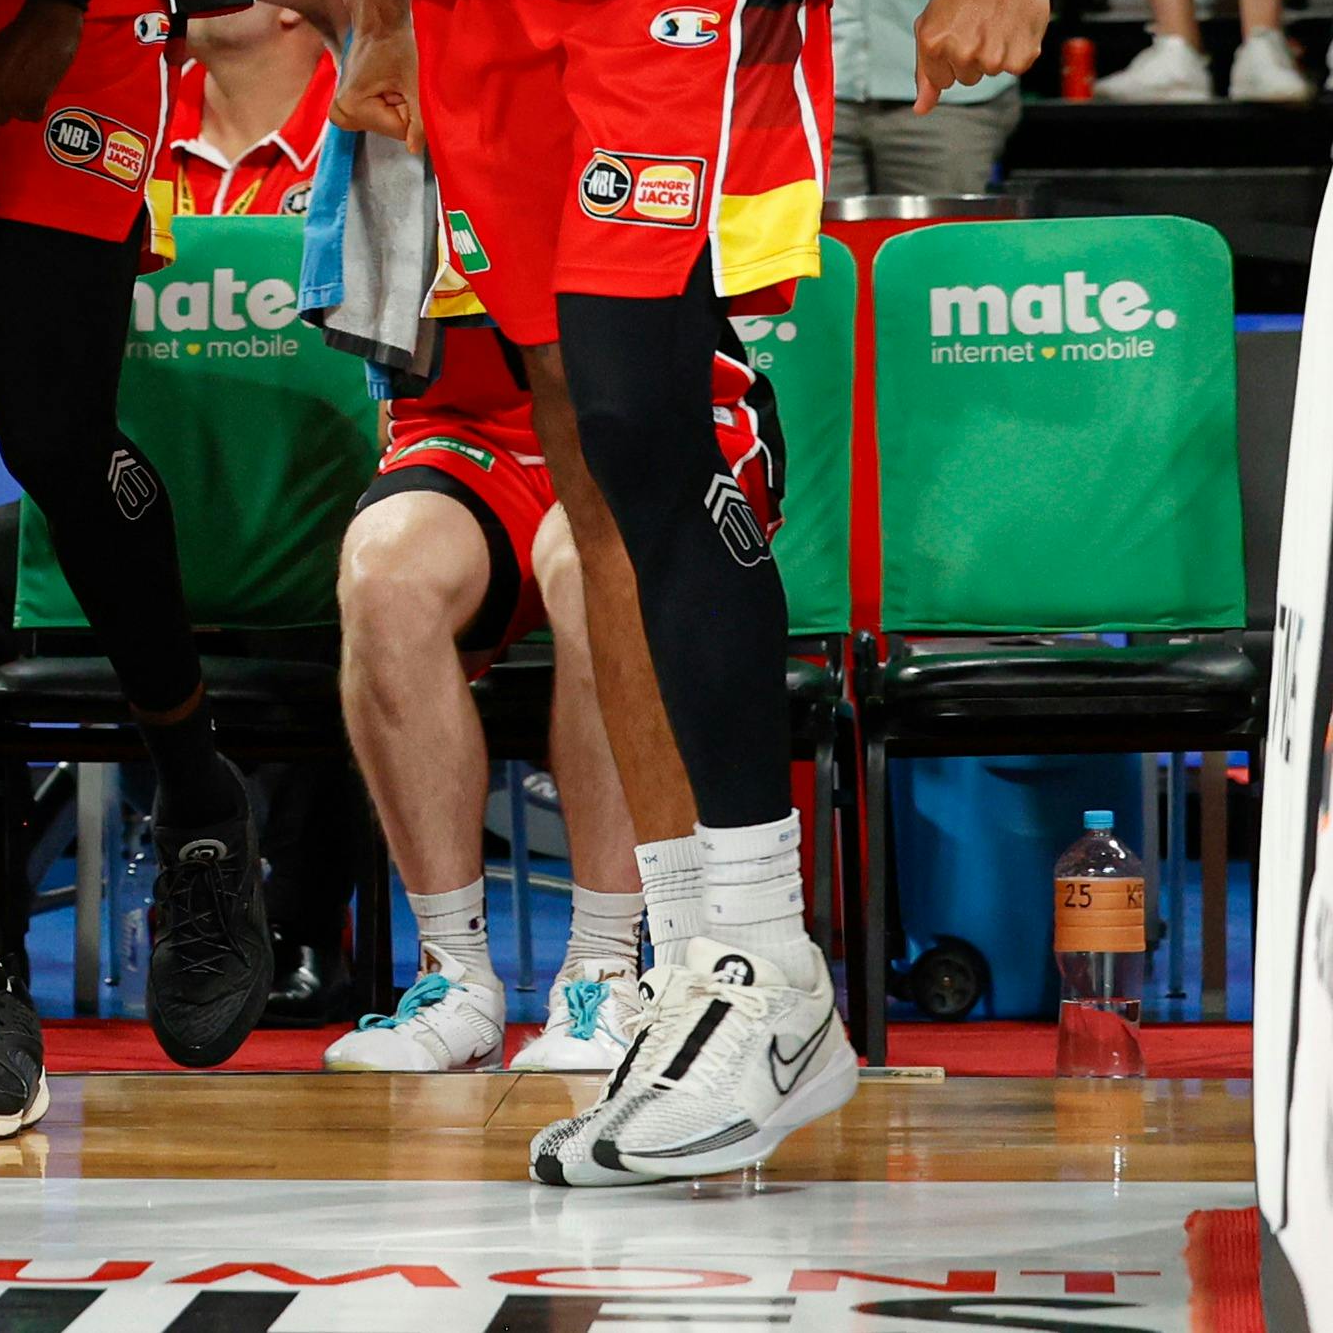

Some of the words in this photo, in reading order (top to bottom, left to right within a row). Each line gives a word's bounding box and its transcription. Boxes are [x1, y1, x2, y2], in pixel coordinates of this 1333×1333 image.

[57, 121, 91, 152] NBL
[108, 140, 143, 161] HUNGRY
[587, 169, 618, 198] NBL
[640, 180, 691, 193] HUNGRY
[637, 190, 690, 207] JACK'S
[929, 271, 1177, 336] mate.
[206, 334, 299, 358] mobile
[932, 340, 1034, 364] internet
[1062, 337, 1155, 362] mobile
[1064, 883, 1093, 908] 25
